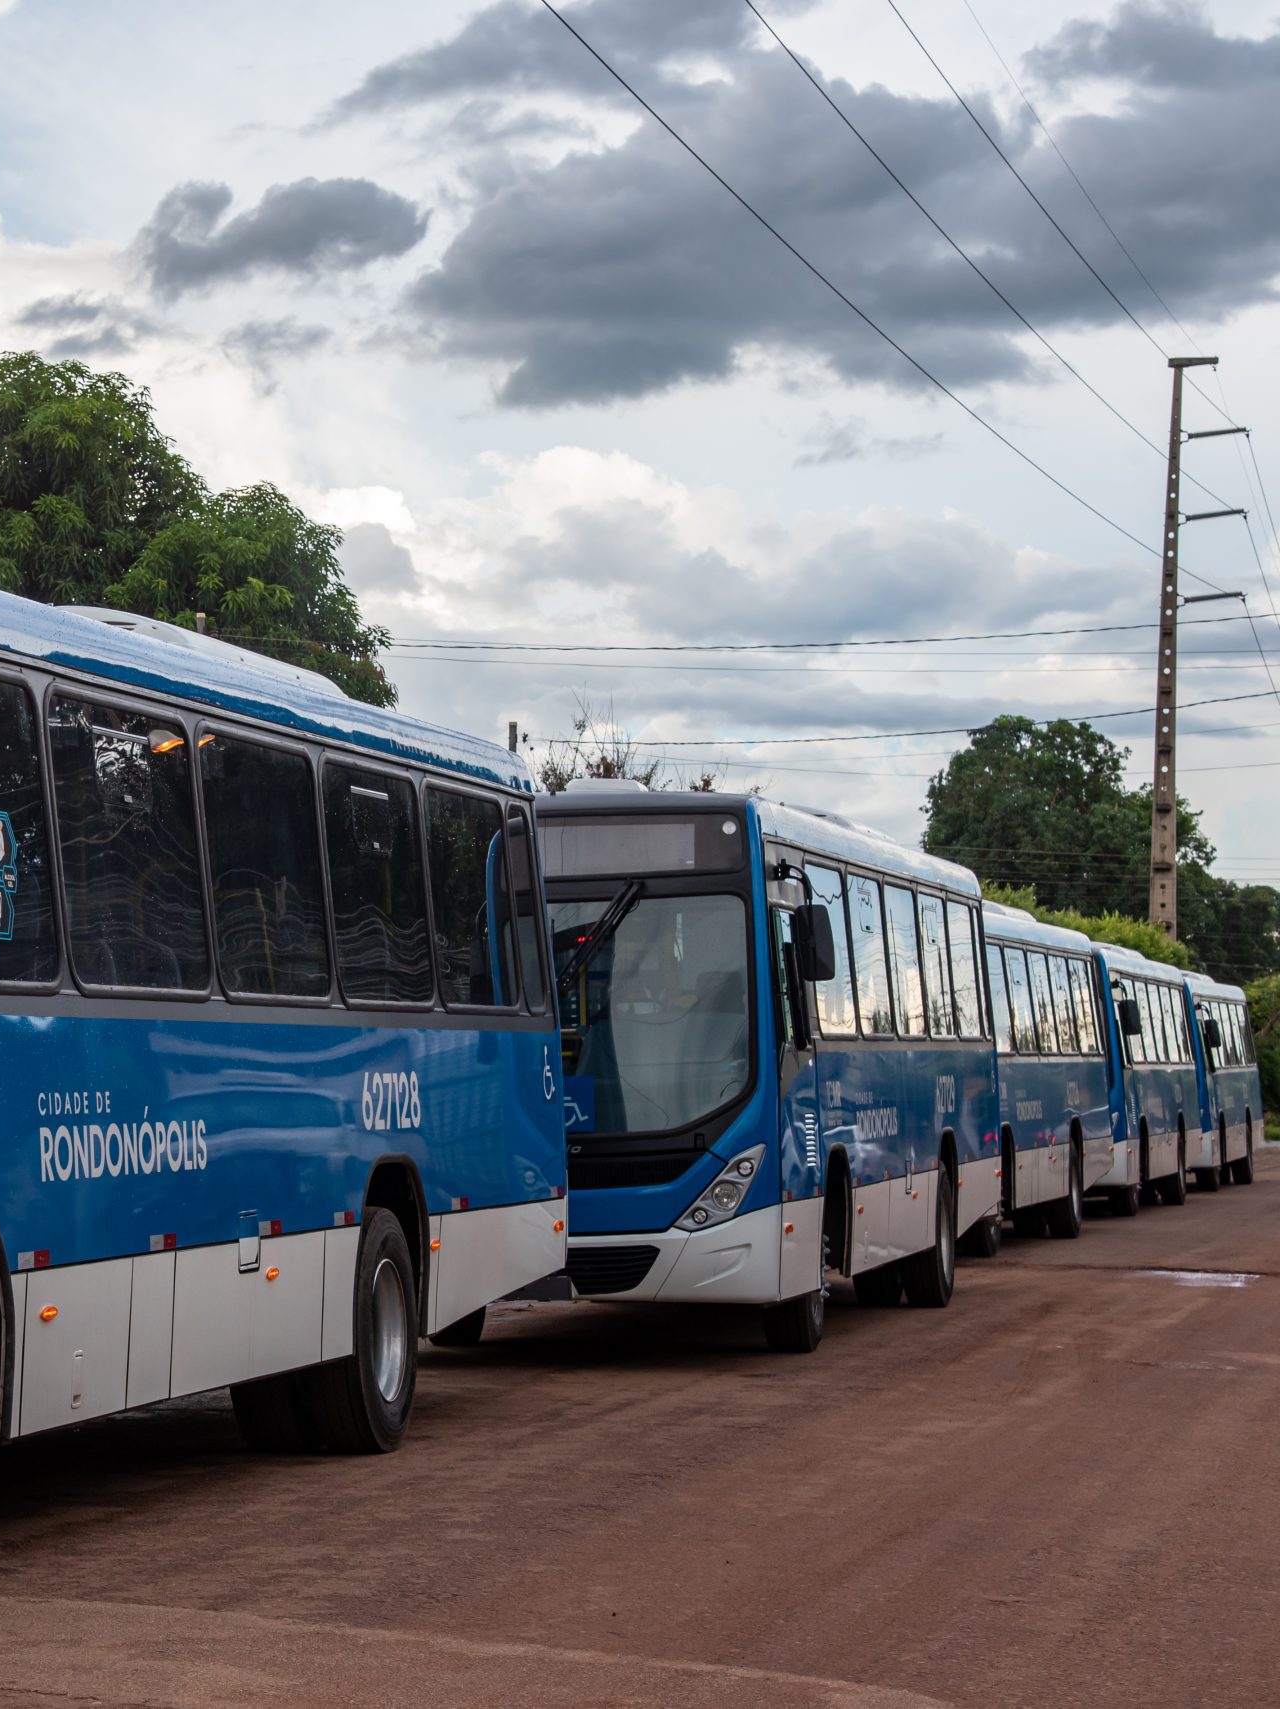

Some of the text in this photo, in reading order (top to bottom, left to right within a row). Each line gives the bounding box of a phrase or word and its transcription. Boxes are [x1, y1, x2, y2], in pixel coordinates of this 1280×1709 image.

[37, 1091, 111, 1116] CIDADE DE
[362, 1070, 421, 1131] 627128
[39, 1105, 208, 1183] RONDONÓPOLIS
